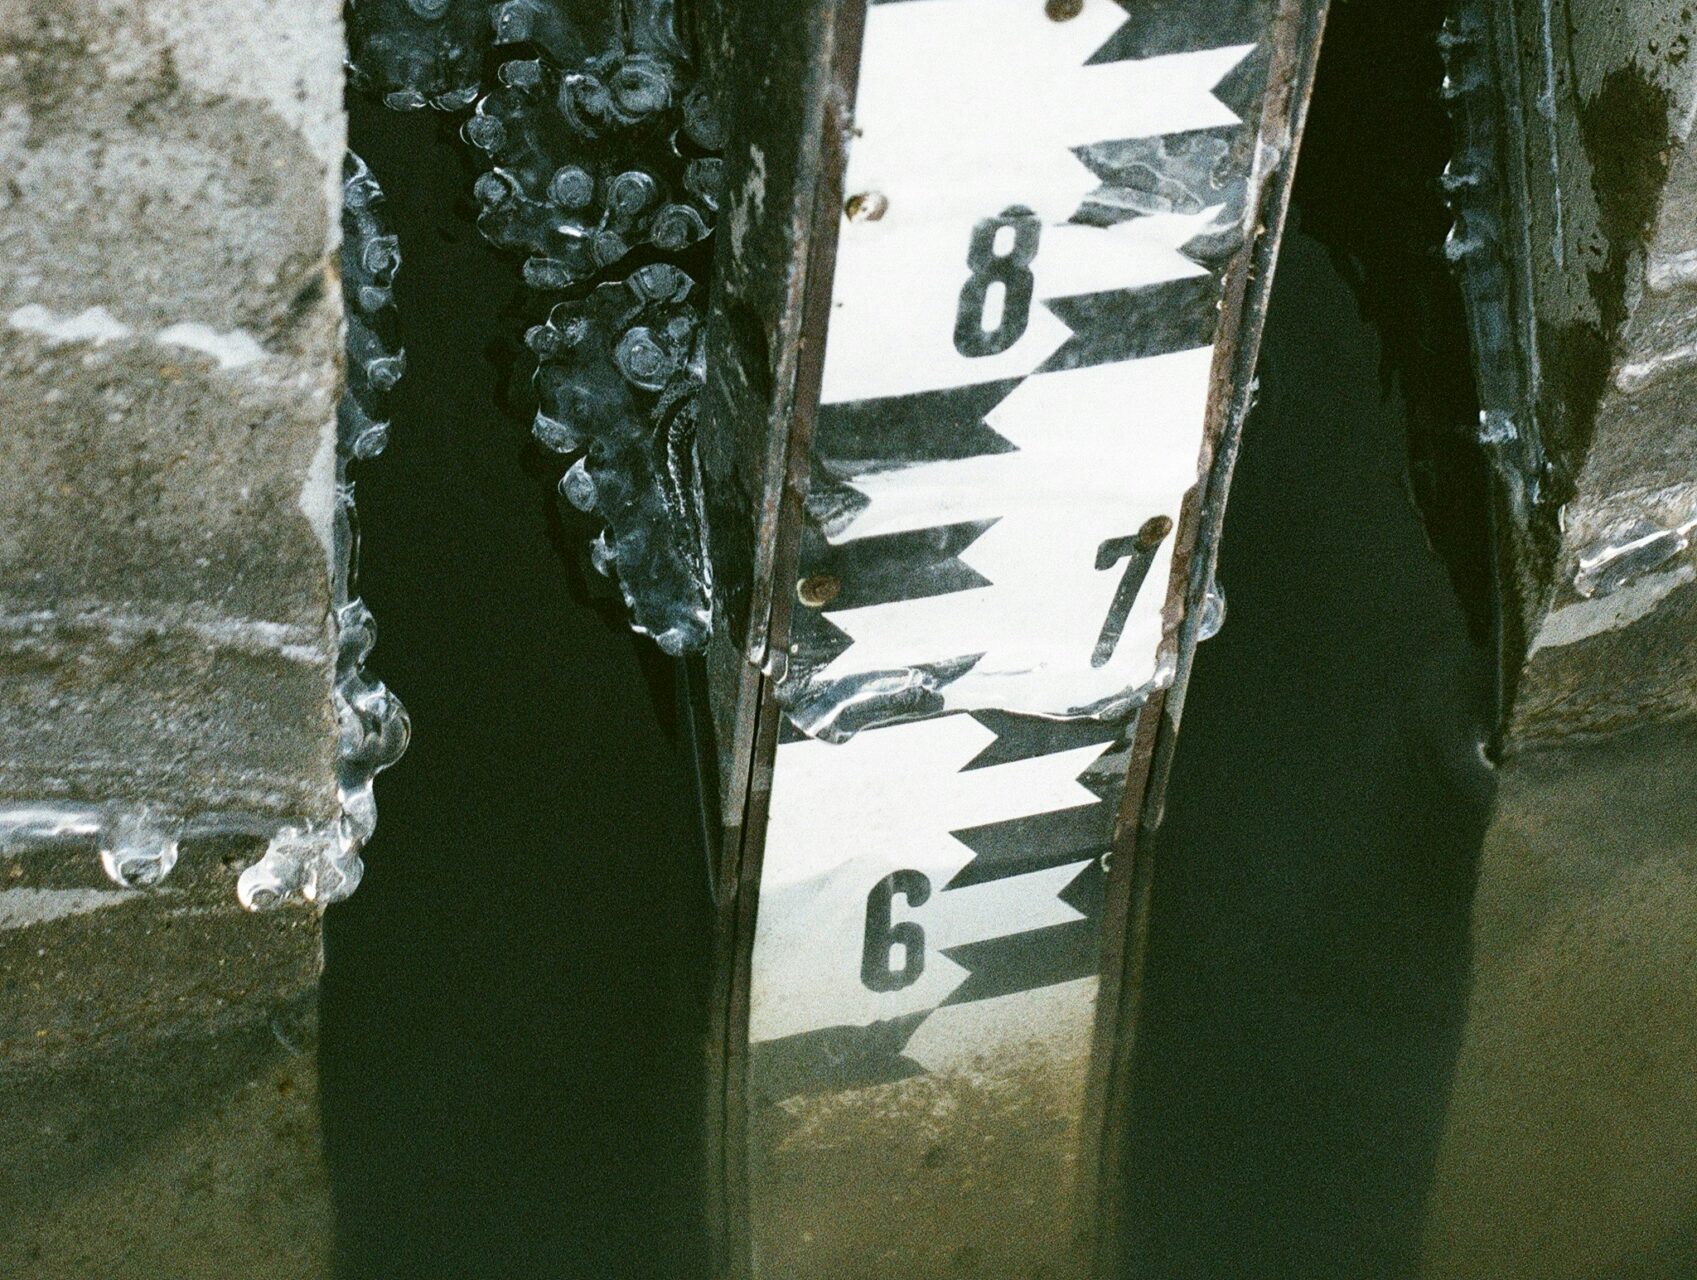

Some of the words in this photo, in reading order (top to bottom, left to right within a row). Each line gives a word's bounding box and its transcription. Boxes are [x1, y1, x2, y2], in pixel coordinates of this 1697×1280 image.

[952, 205, 1041, 358] 8
[1089, 528, 1172, 668] 7
[860, 868, 932, 993] 6
